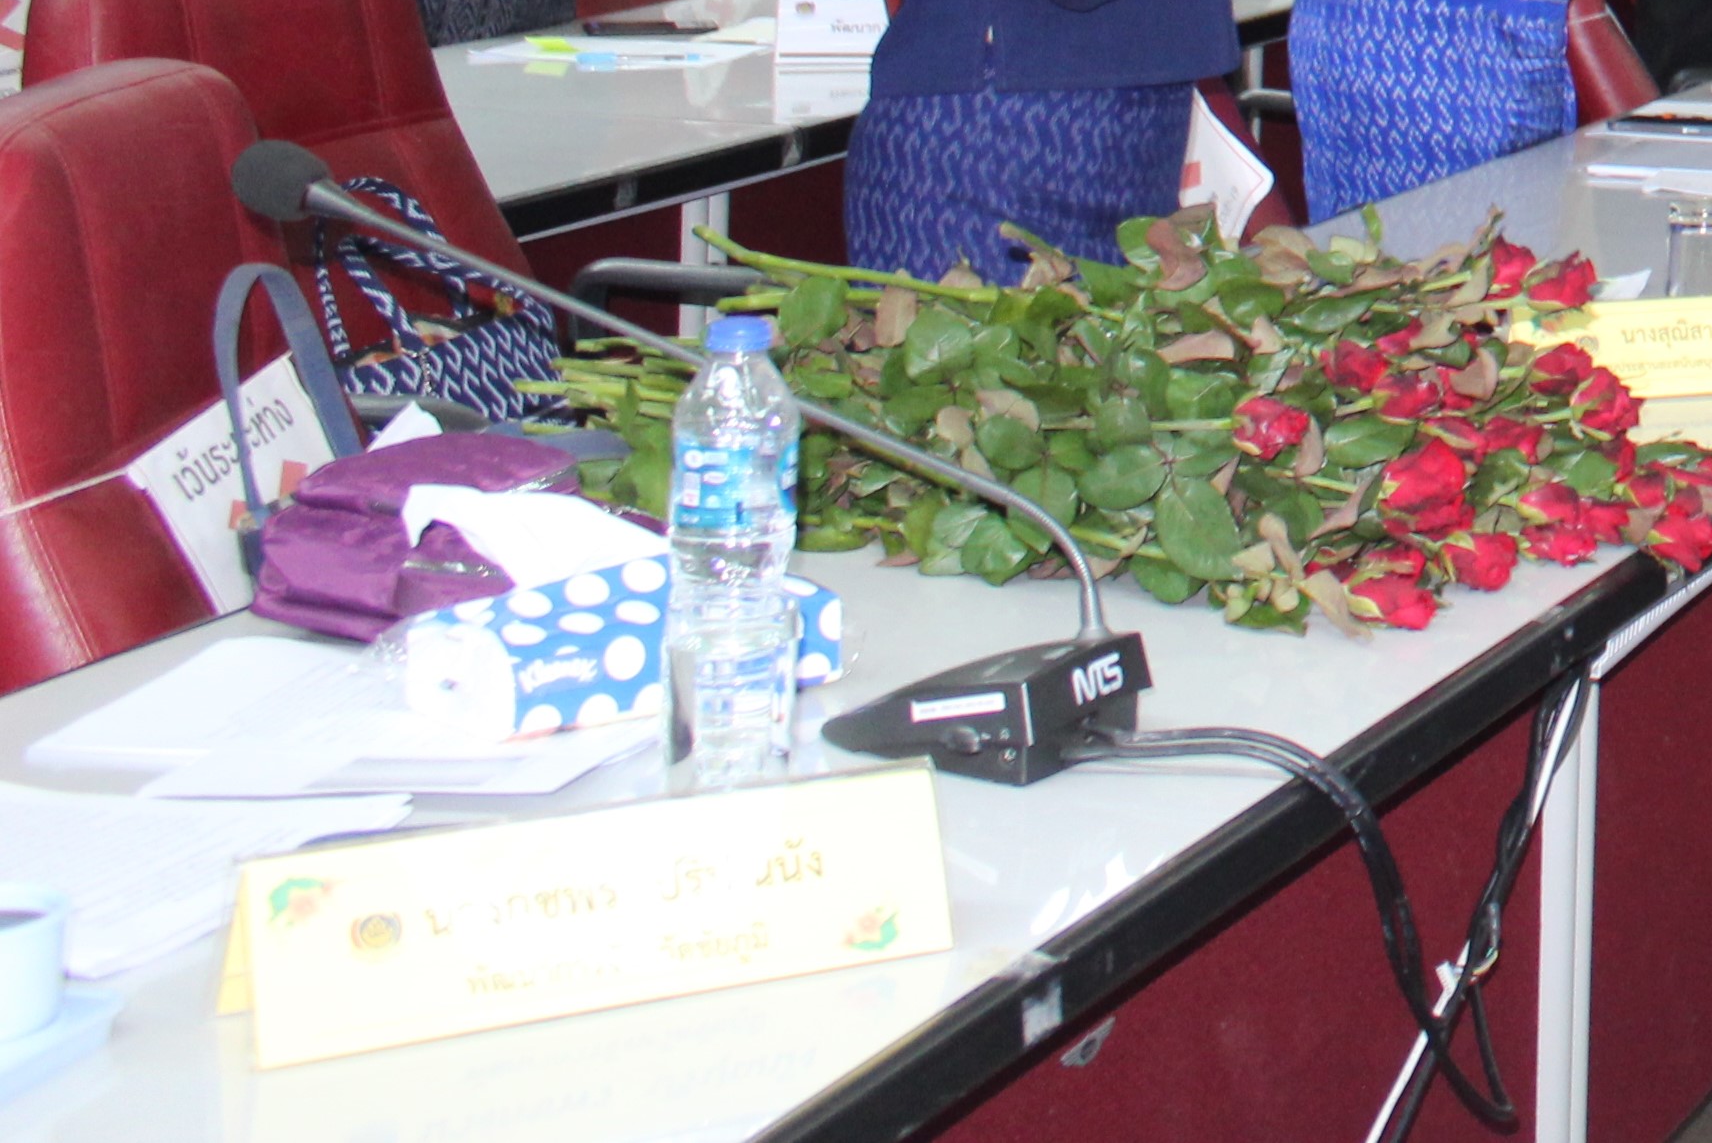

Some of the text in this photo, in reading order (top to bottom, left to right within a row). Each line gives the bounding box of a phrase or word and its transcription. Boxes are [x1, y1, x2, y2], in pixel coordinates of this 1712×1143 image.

[171, 396, 295, 502] เว้นระะห่าง
